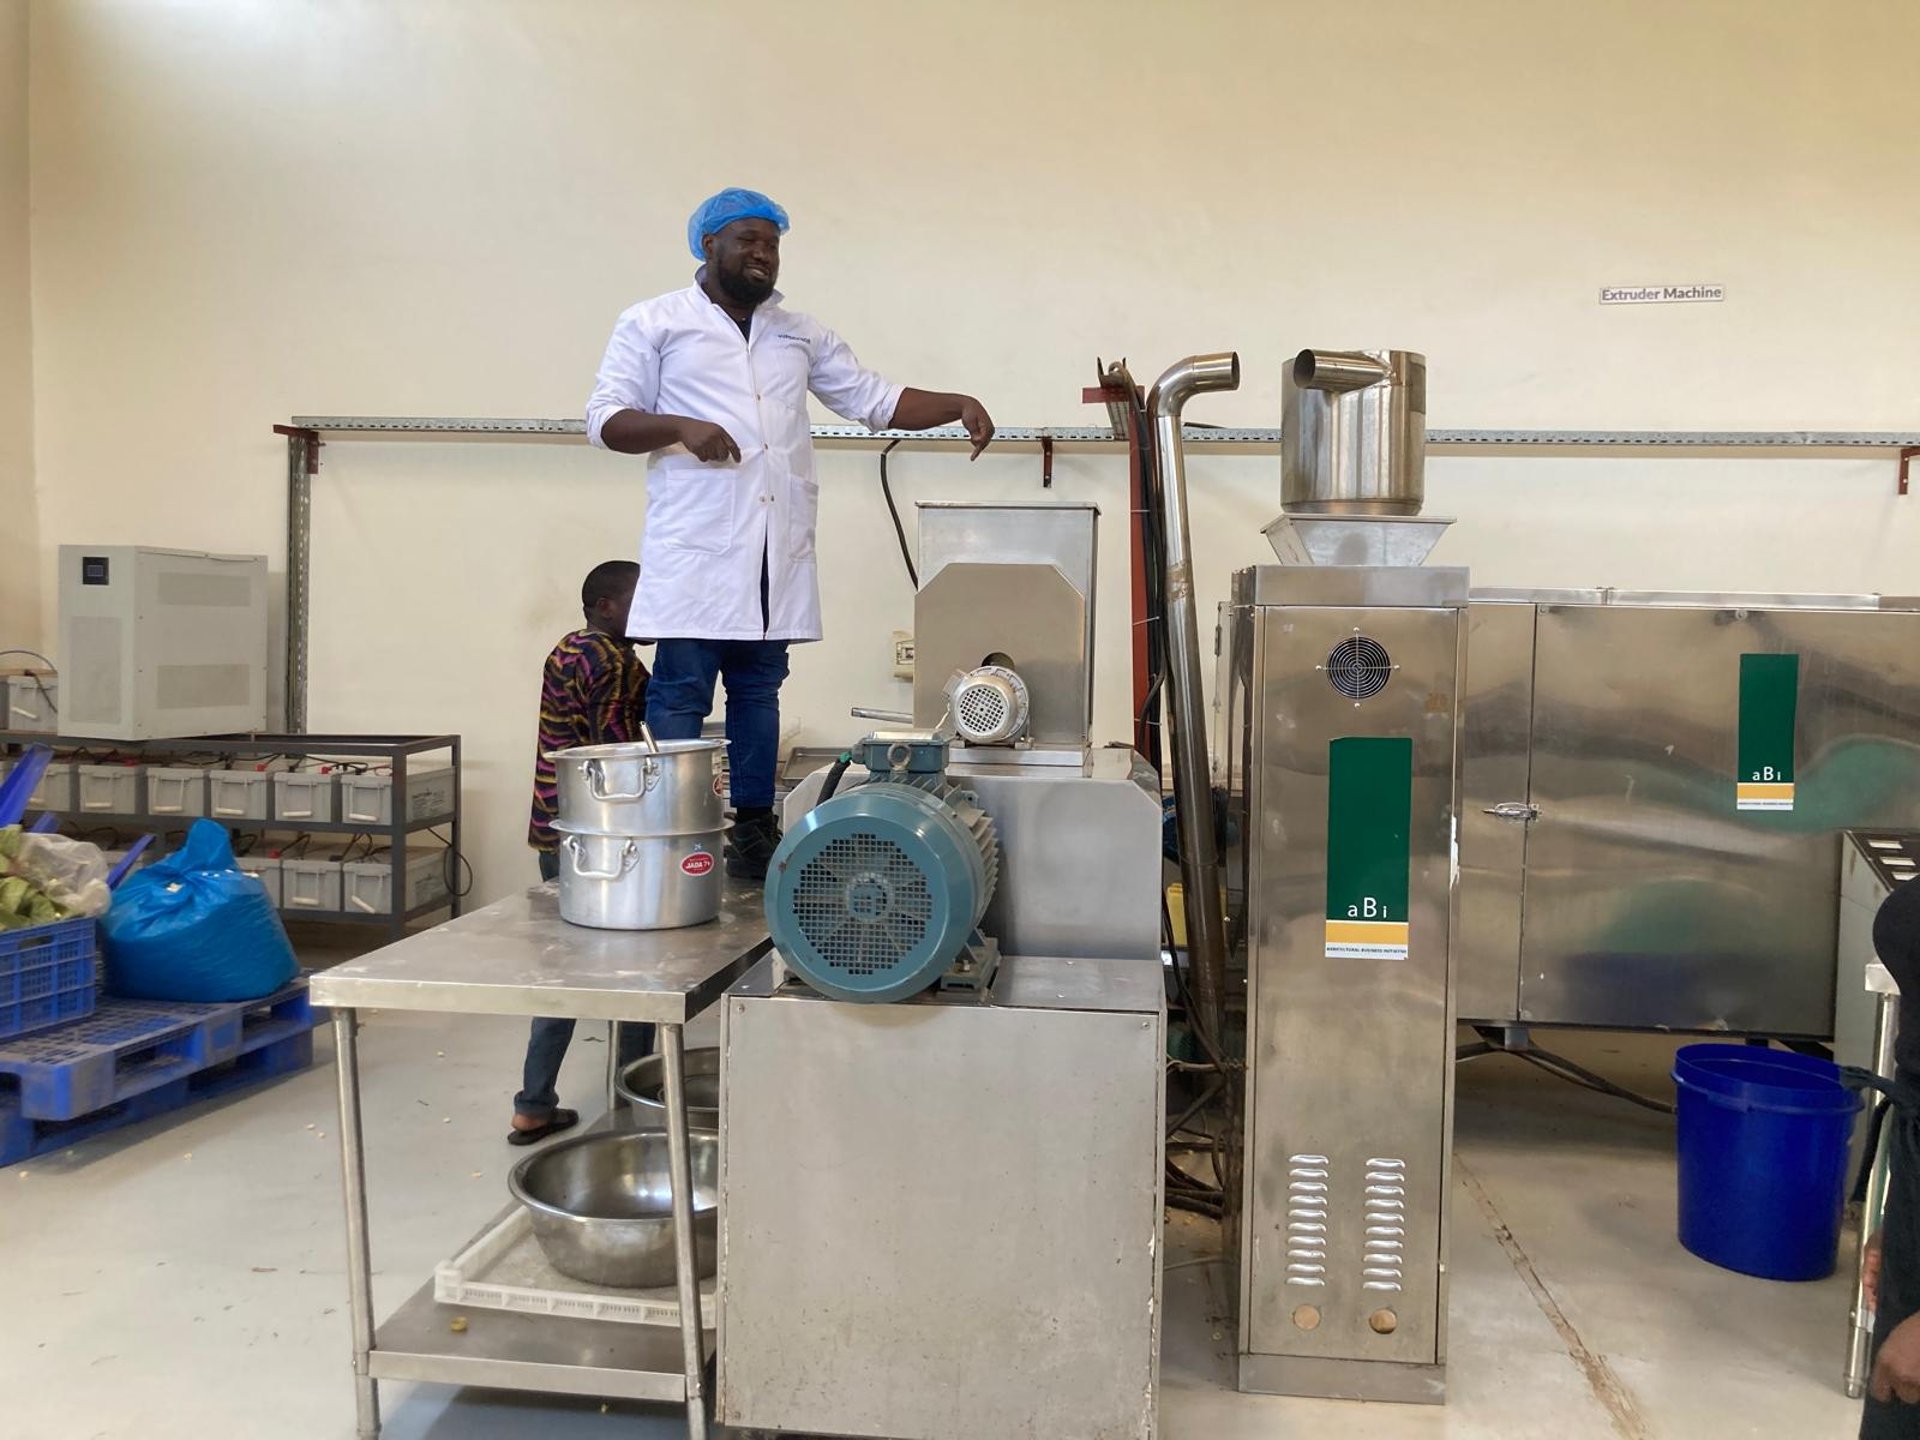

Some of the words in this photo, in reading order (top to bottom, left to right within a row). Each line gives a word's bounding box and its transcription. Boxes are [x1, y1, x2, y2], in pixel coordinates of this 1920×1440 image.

[1602, 288, 1661, 300] Extruder
[1663, 286, 1722, 299] Machine
[1752, 766, 1781, 781] aBi
[1347, 897, 1387, 918] aBi
